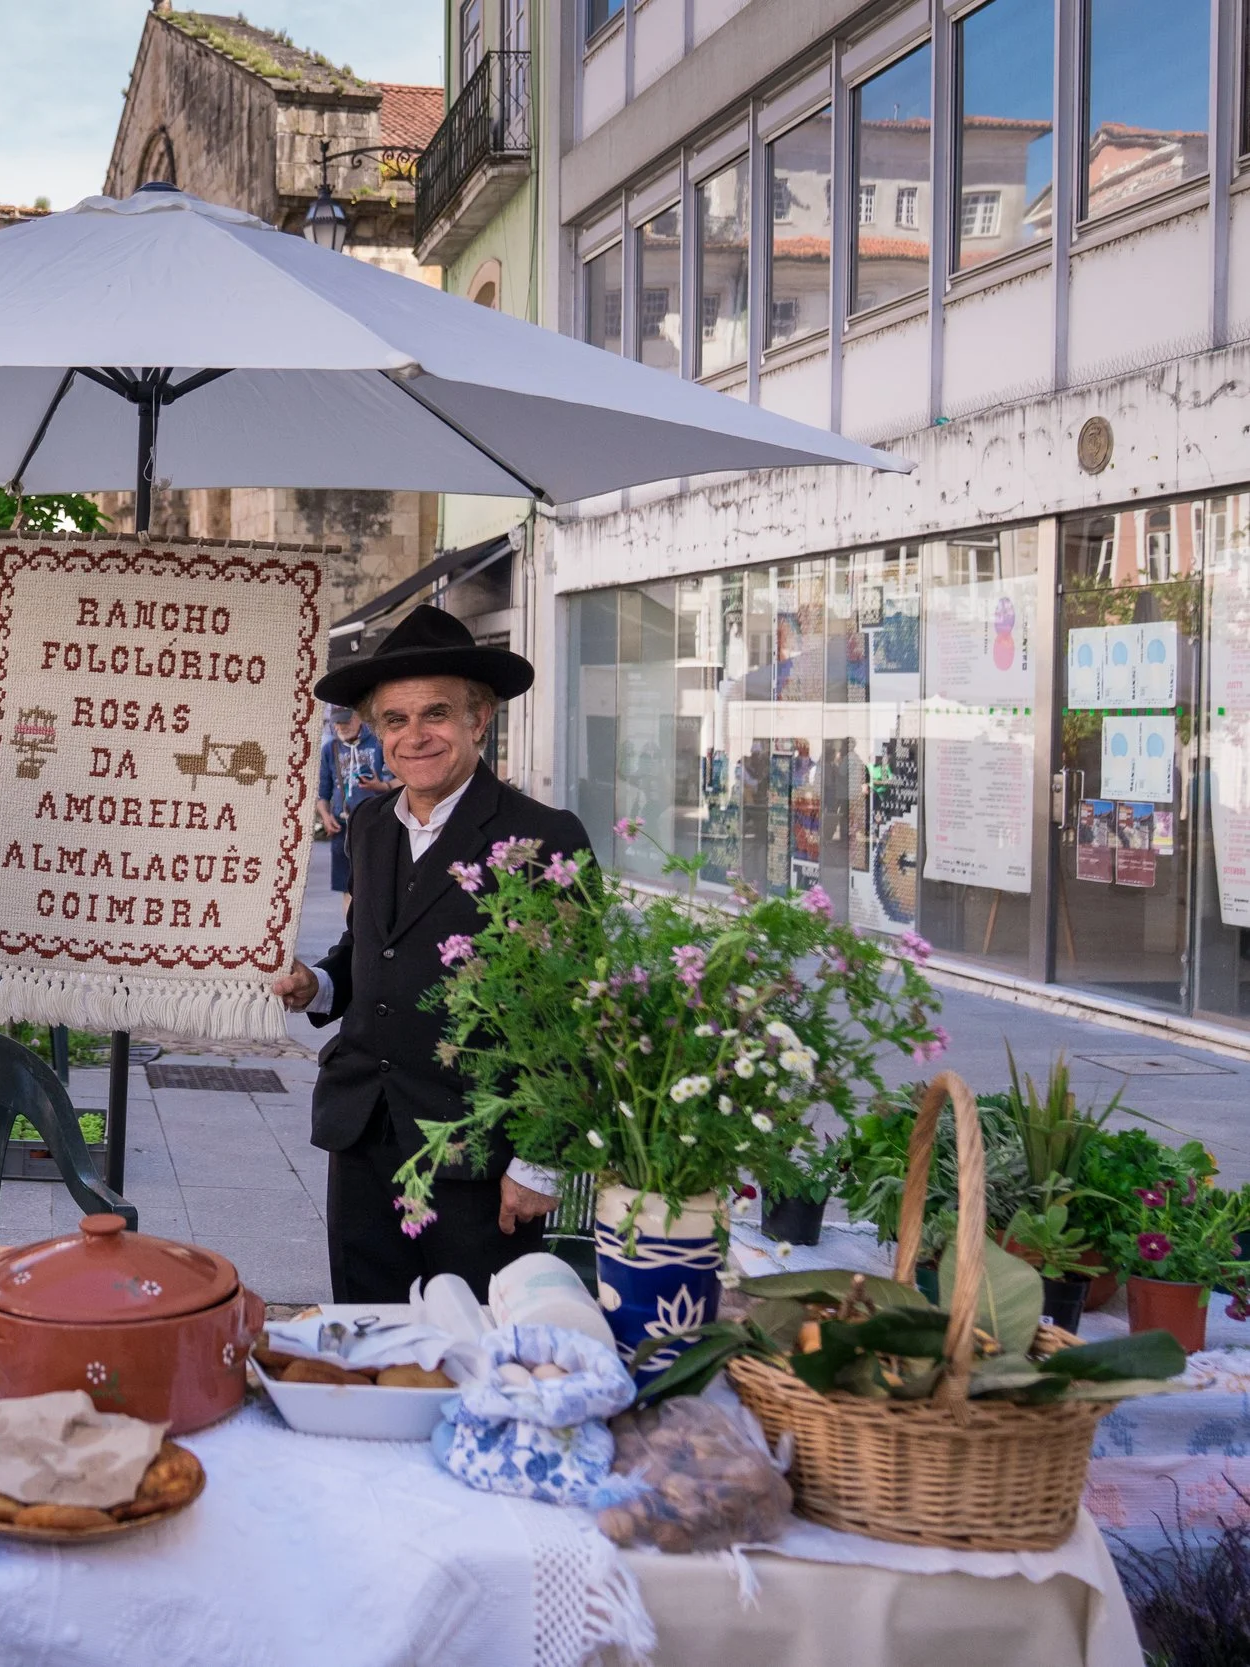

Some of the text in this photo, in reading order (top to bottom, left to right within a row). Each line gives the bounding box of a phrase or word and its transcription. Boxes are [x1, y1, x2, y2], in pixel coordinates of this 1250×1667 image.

[77, 598, 231, 636] RANCHO
[41, 638, 266, 685] FOLCLÓRICO
[72, 697, 191, 734] ROSAS
[89, 747, 139, 780] DA
[35, 791, 238, 832] AMOREIRA
[2, 841, 263, 885] ALMALAGUÊS
[37, 889, 222, 929] COIMBRA
